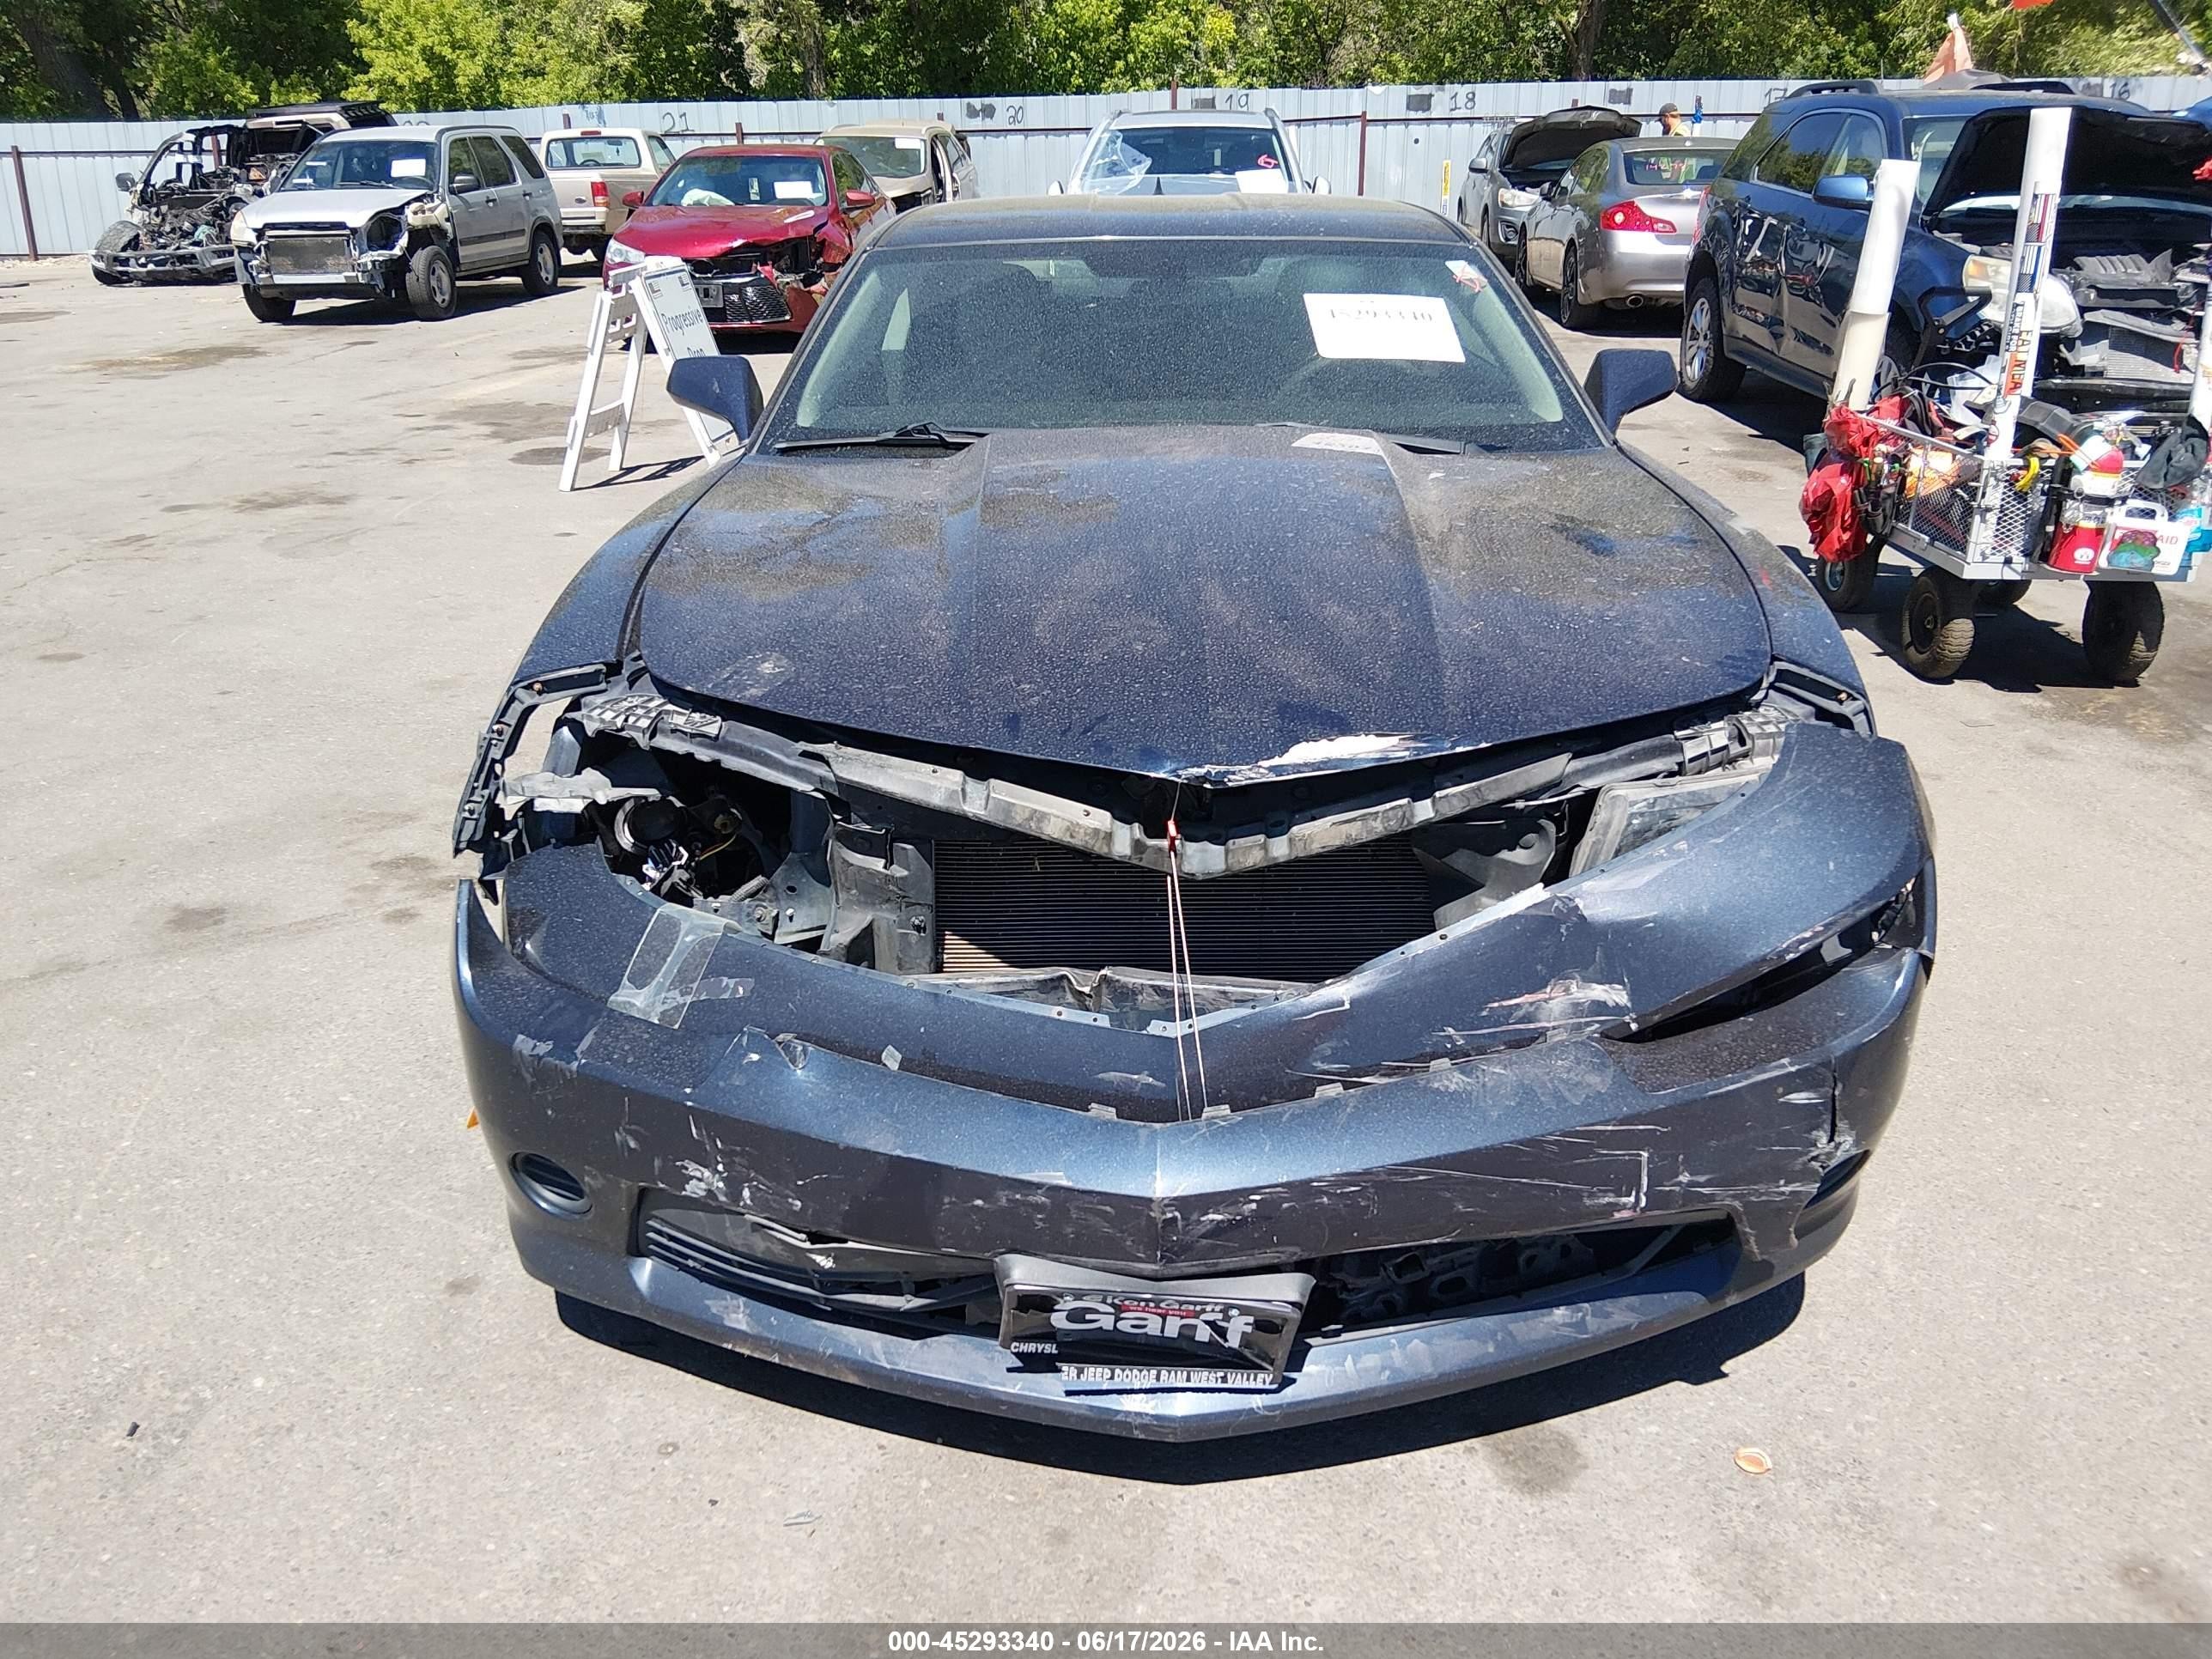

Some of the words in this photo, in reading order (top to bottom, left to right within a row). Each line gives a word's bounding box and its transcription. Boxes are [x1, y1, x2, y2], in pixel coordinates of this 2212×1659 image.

[1449, 91, 1476, 112] 18
[2110, 82, 2130, 101] 16
[1224, 93, 1249, 111] 19
[662, 112, 696, 134] 21
[1006, 105, 1024, 126] 20
[660, 308, 704, 337] Progressive
[2012, 307, 2024, 333] BRAKE
[2008, 335, 2019, 352] FOR
[2017, 330, 2033, 354] EAT
[2009, 360, 2027, 396] MEAT
[2157, 534, 2179, 545] AID
[1159, 1300, 1224, 1312] Garff
[1010, 1341, 1059, 1354] CHRYSL
[1080, 1367, 1111, 1382] JEEP
[1115, 1368, 1157, 1383] DODGE
[1159, 1369, 1187, 1384] RAM
[1190, 1370, 1224, 1385] WEST
[1227, 1371, 1273, 1387] VALLEY
